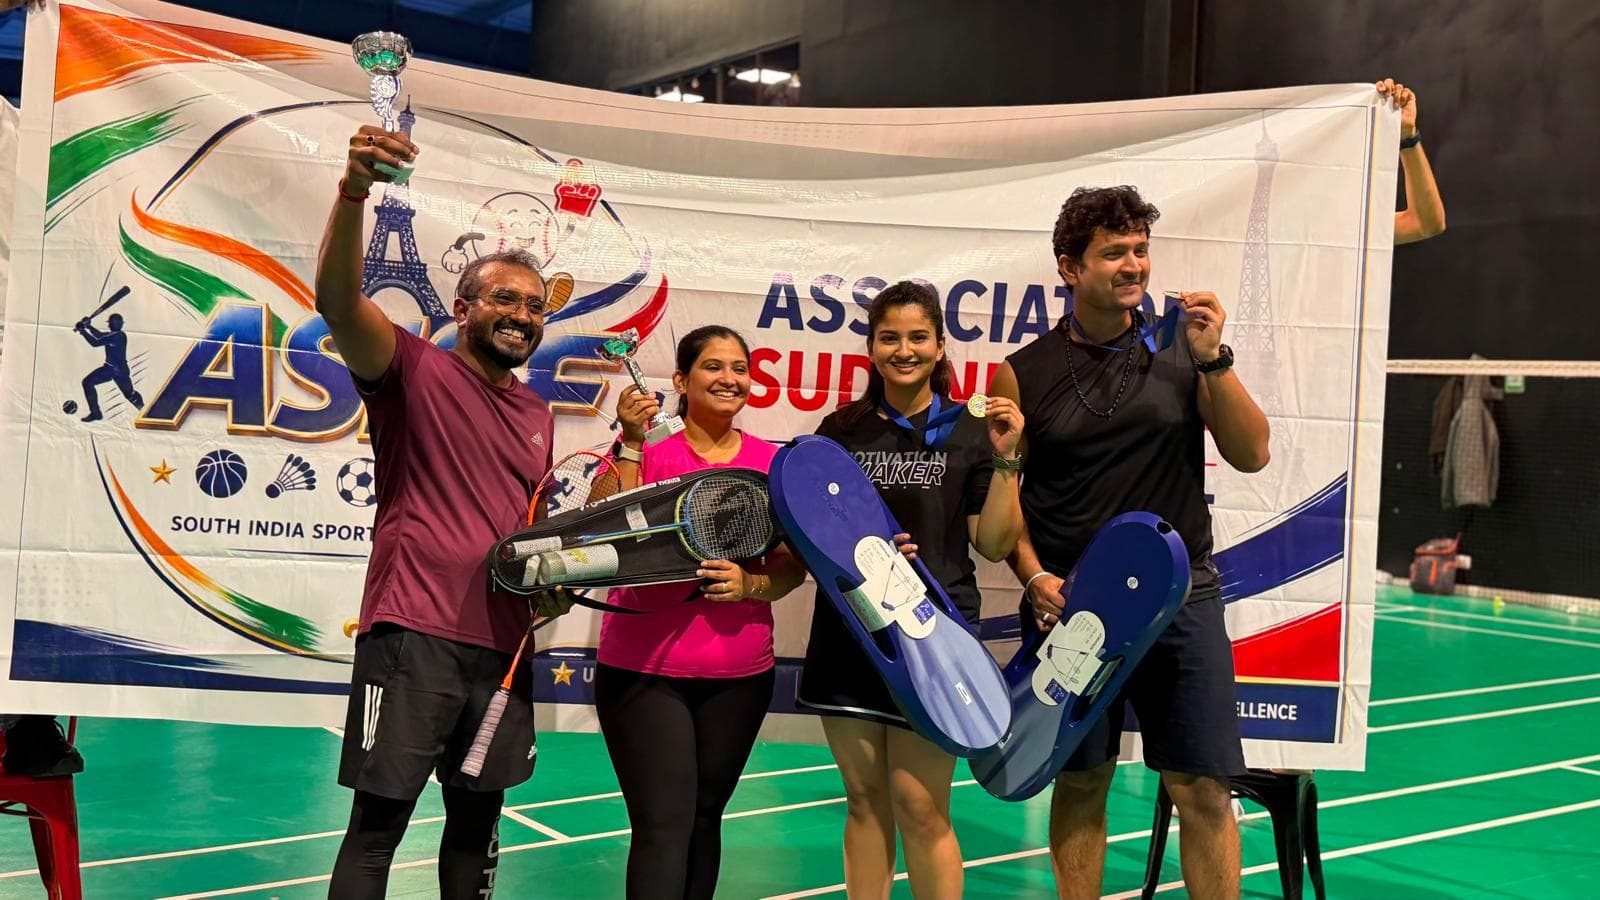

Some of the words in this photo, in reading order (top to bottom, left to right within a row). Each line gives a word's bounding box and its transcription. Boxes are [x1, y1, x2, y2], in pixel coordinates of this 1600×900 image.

[852, 451, 948, 465] OTIVATION
[171, 515, 240, 534] SOUTH
[248, 520, 305, 538] INDIA
